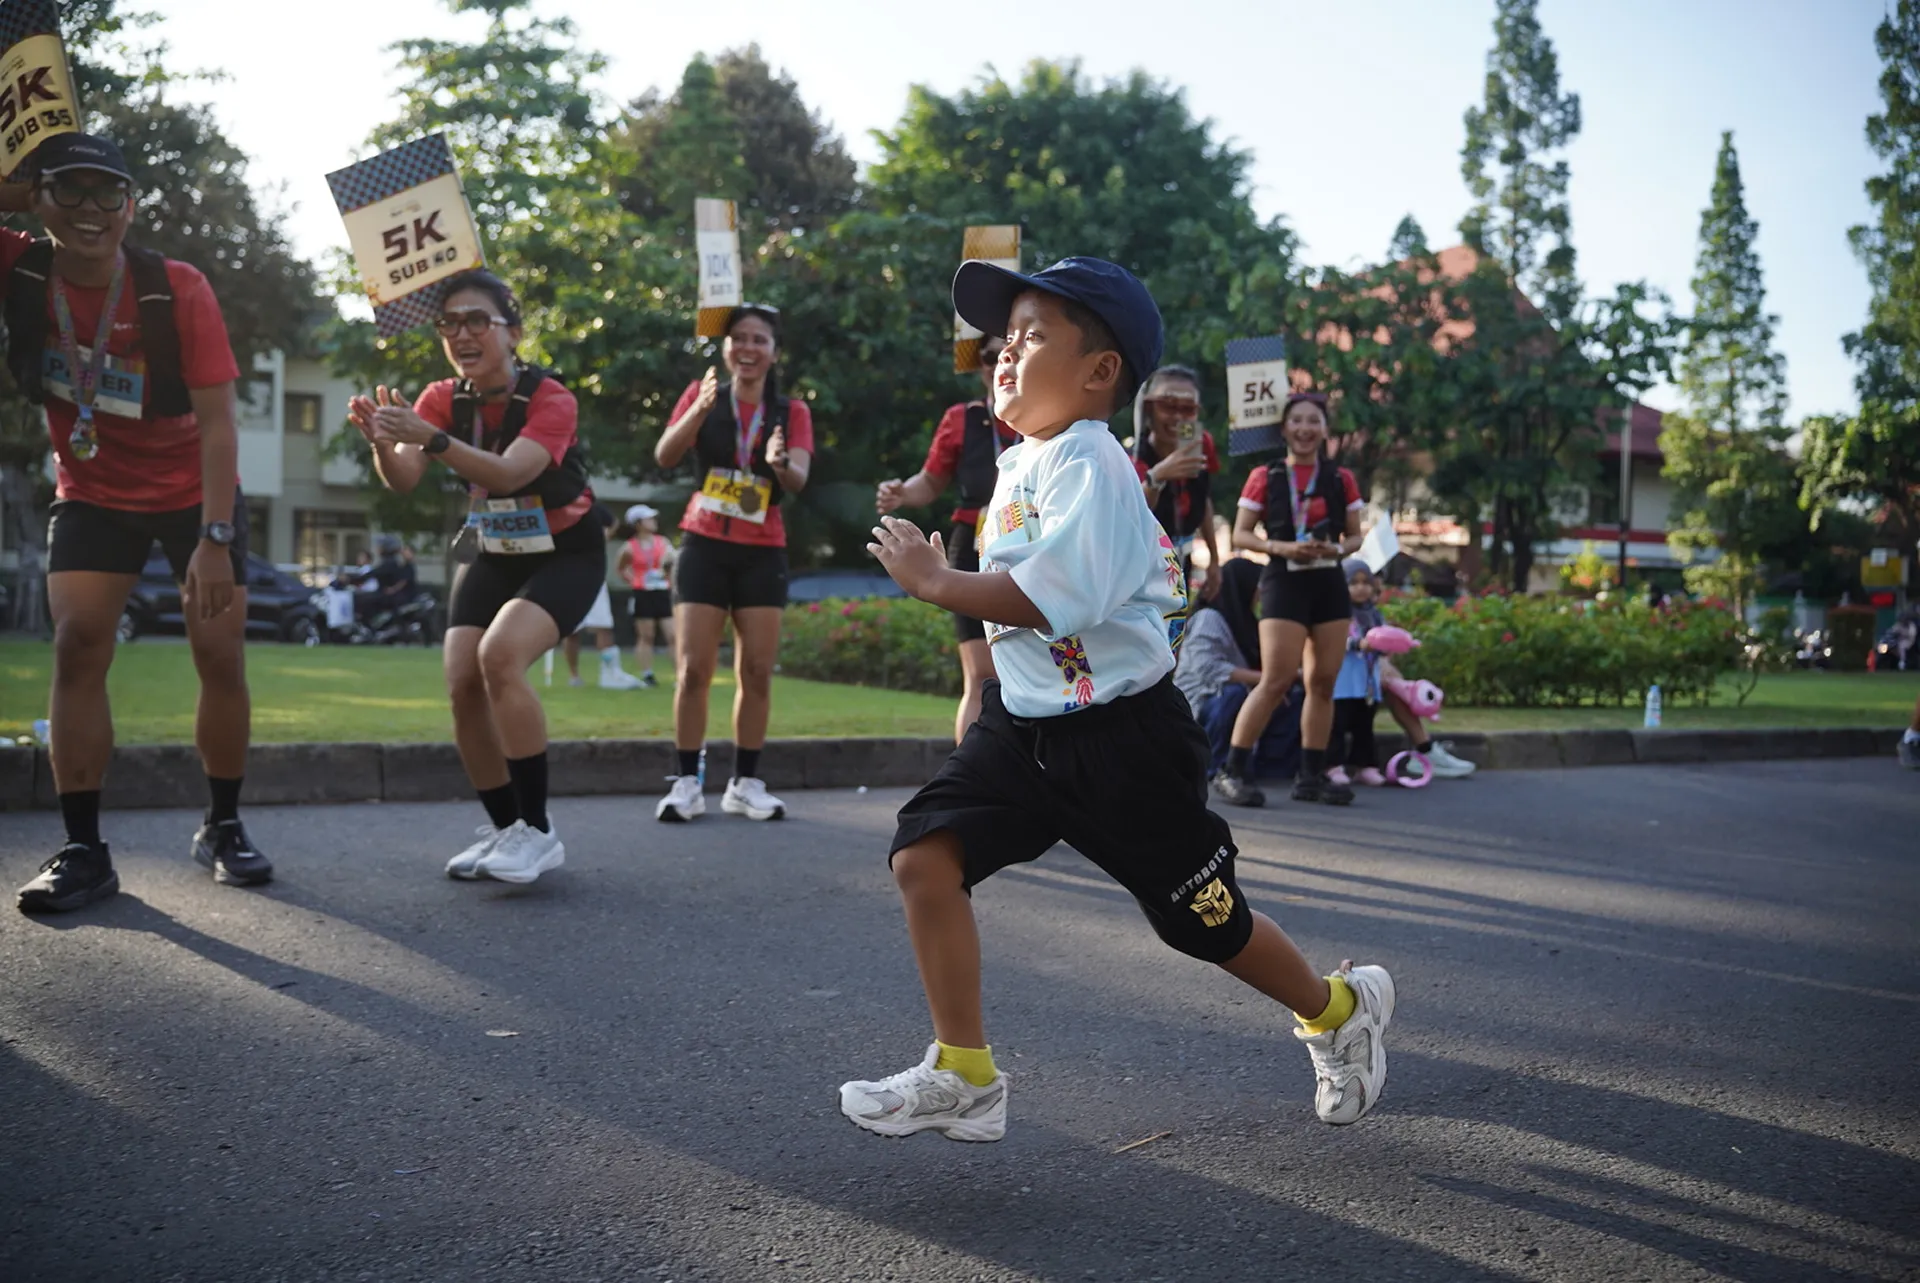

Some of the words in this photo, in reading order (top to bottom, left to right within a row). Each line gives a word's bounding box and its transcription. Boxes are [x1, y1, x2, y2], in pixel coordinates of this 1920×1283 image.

[6, 117, 40, 155] SUB
[382, 209, 447, 264] 5K
[389, 259, 430, 285] SUB
[49, 357, 134, 395] PER
[1244, 380, 1274, 403] 5K
[481, 514, 540, 533] PACER
[1170, 845, 1229, 903] AUTOBOTS
